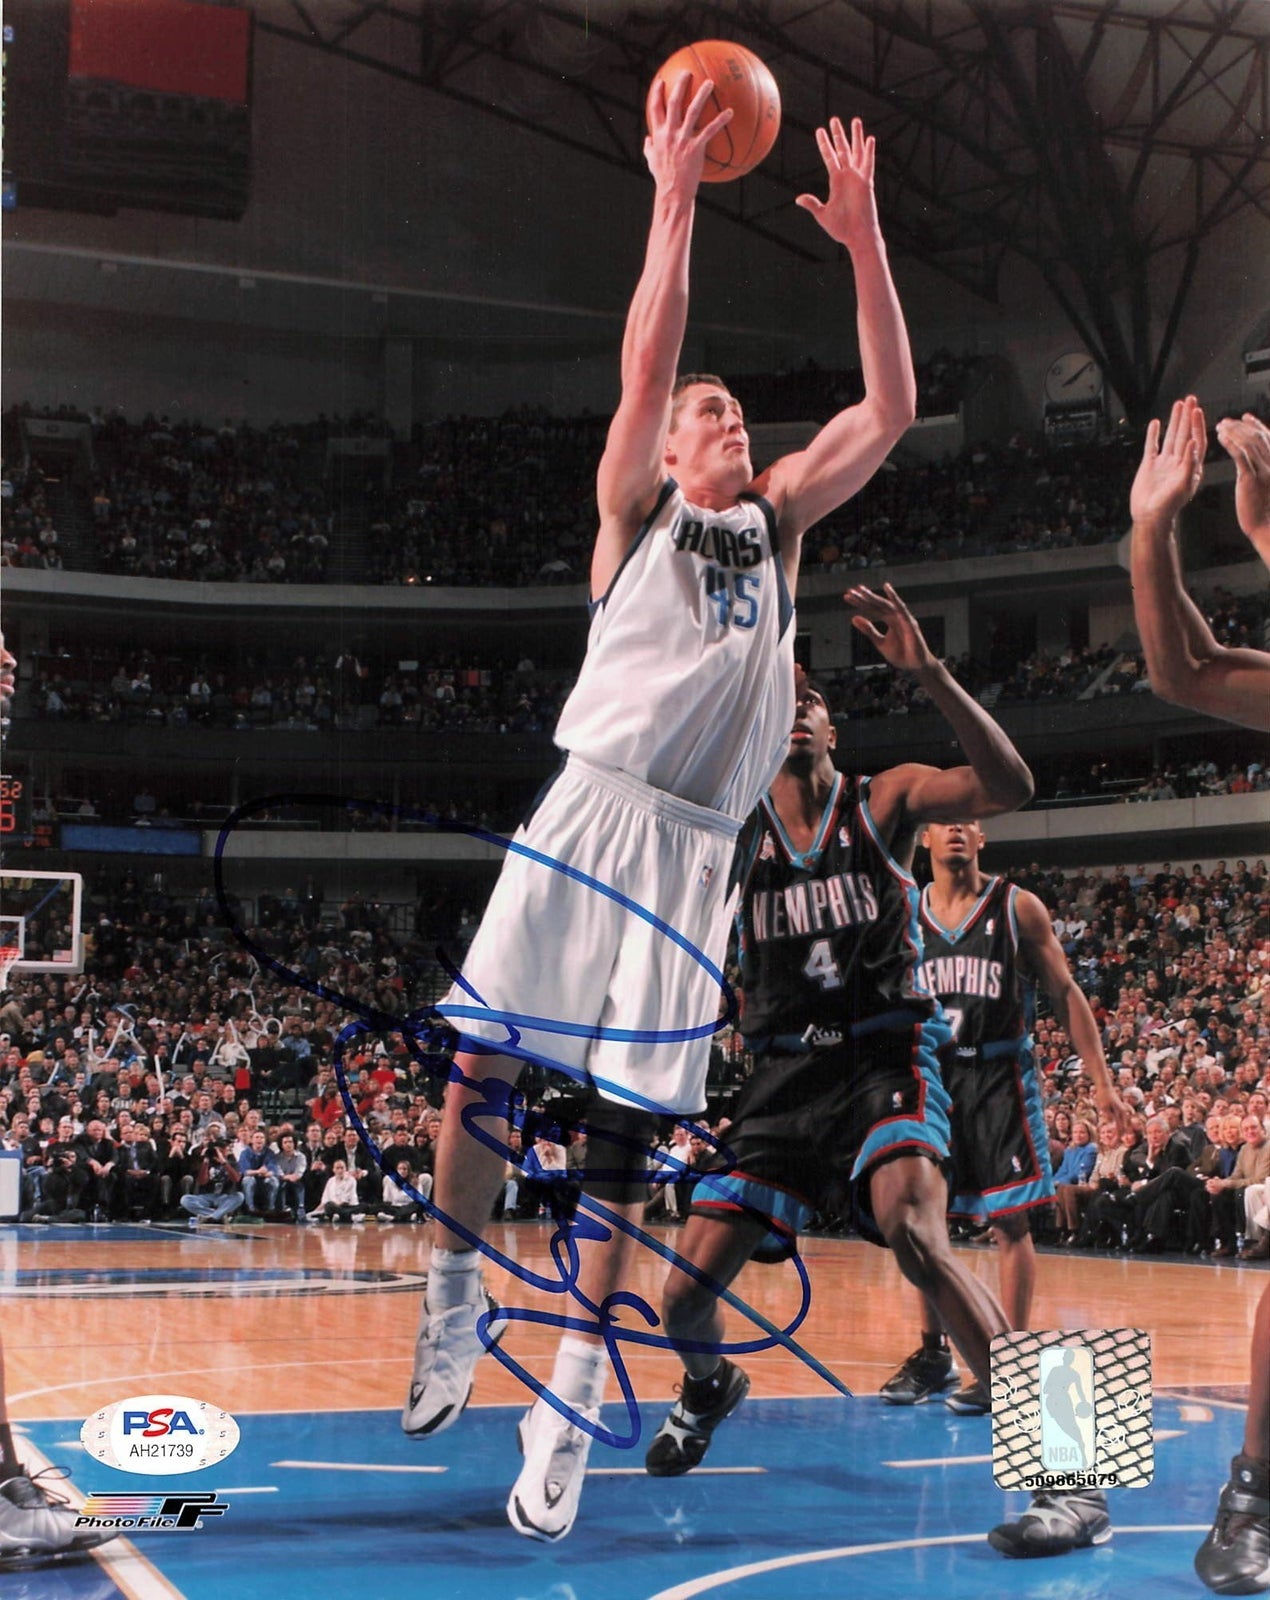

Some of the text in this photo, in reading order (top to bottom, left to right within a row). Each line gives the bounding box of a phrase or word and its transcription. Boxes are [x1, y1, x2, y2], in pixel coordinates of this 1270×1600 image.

[706, 565, 761, 629] 45
[753, 872, 879, 943] MEMPHIS
[802, 938, 845, 990] 4
[123, 1407, 199, 1438] PSA
[129, 1443, 194, 1457] AH21739
[1048, 1446, 1079, 1463] NBA
[1024, 1472, 1118, 1488] 509865079
